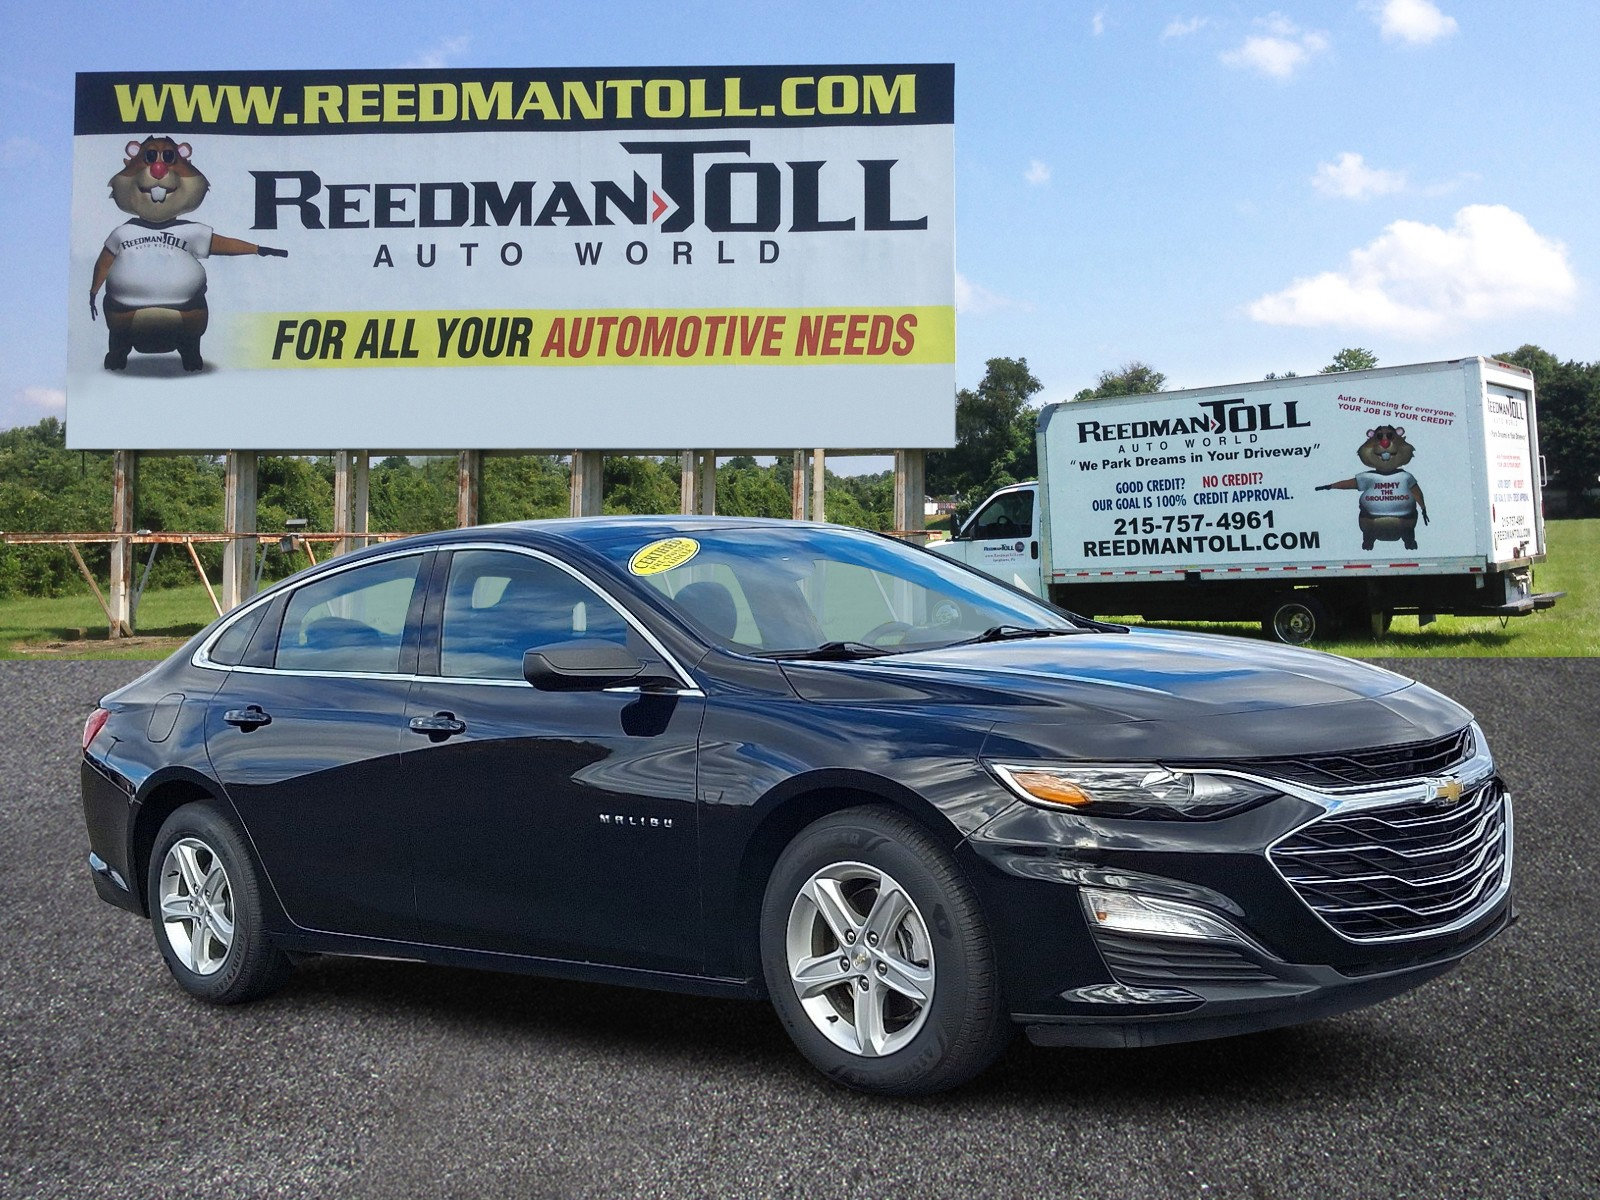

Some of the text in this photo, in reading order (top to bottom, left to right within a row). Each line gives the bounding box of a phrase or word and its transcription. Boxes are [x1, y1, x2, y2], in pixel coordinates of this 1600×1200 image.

[114, 74, 916, 124] WWW.REEDMANTOLL.COM
[373, 240, 780, 268] AUTO WORLD
[272, 313, 918, 360] FOR ALL YOUR AUTOMOTIVE NEEDS
[1338, 394, 1457, 418] Auto Financing for everyone.
[1338, 403, 1361, 412] YOUR
[1363, 407, 1381, 415] JOB
[1394, 411, 1418, 421] YOUR
[1420, 415, 1454, 426] CREDIT
[1118, 434, 1258, 453] AUTO WORLD
[1102, 458, 1131, 469] Park
[1136, 455, 1187, 467] Dreams
[1191, 452, 1203, 463] in
[1207, 451, 1240, 461] Your
[1116, 472, 1263, 494] GOOD CREDIT? NO CREDIT?
[1373, 482, 1400, 490] JIMMY
[1092, 487, 1294, 512] OUR GOAL IS 100% CREDIT APPROVAL.
[1365, 494, 1410, 502] GROUNDHOG
[1114, 510, 1275, 536] 215-757-4961
[634, 540, 682, 569] CERTIFIED
[1084, 531, 1320, 557] REEDMANTOLL.COM
[599, 813, 672, 828] MALIBU
